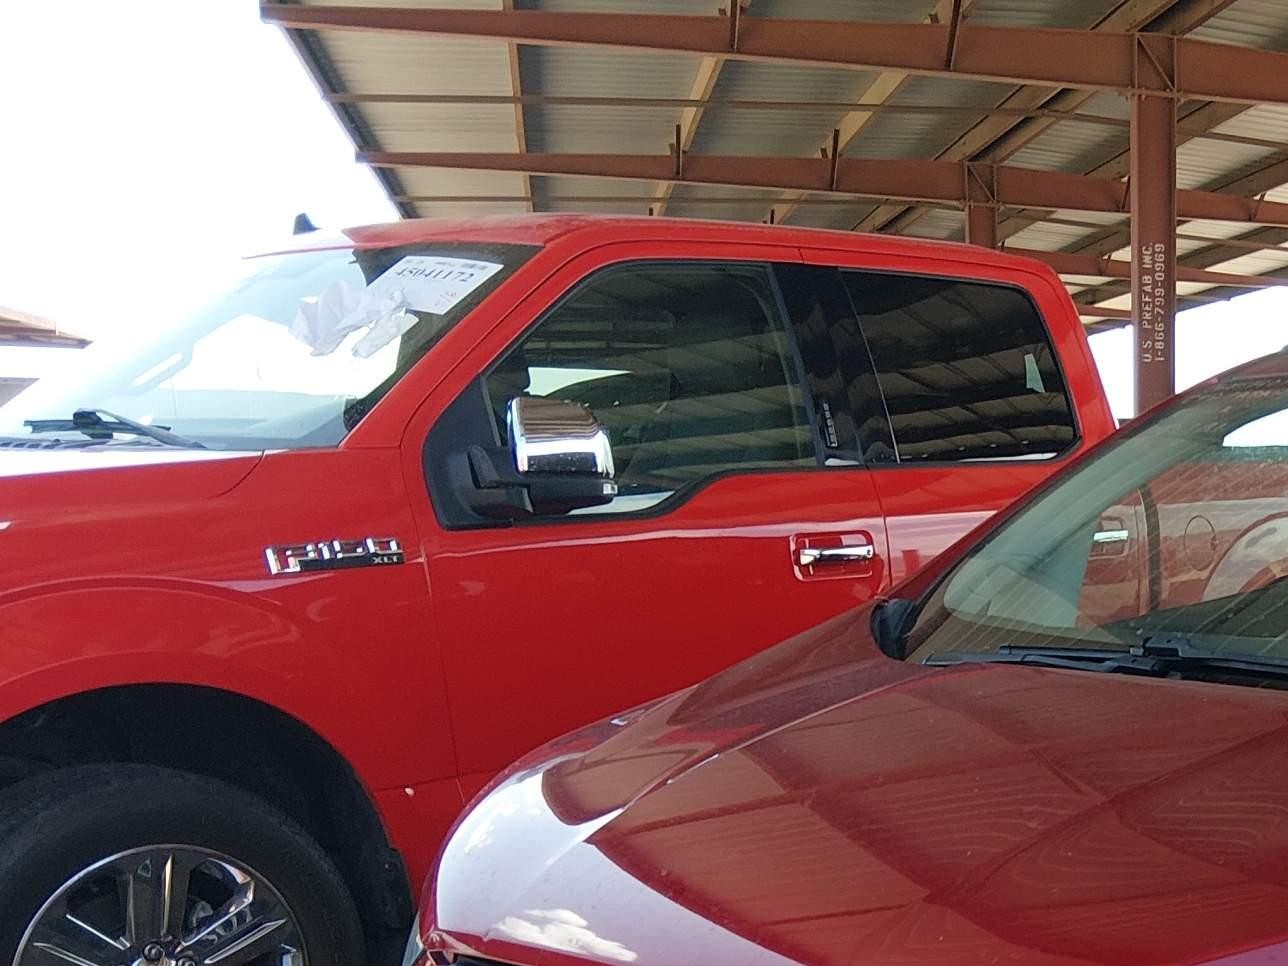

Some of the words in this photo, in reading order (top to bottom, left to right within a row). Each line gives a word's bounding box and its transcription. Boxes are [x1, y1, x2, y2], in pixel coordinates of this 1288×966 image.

[1142, 242, 1153, 268] INC.
[1142, 275, 1153, 329] PREFAB
[1154, 243, 1165, 361] 1-866-799-0969
[371, 556, 400, 564] XLT
